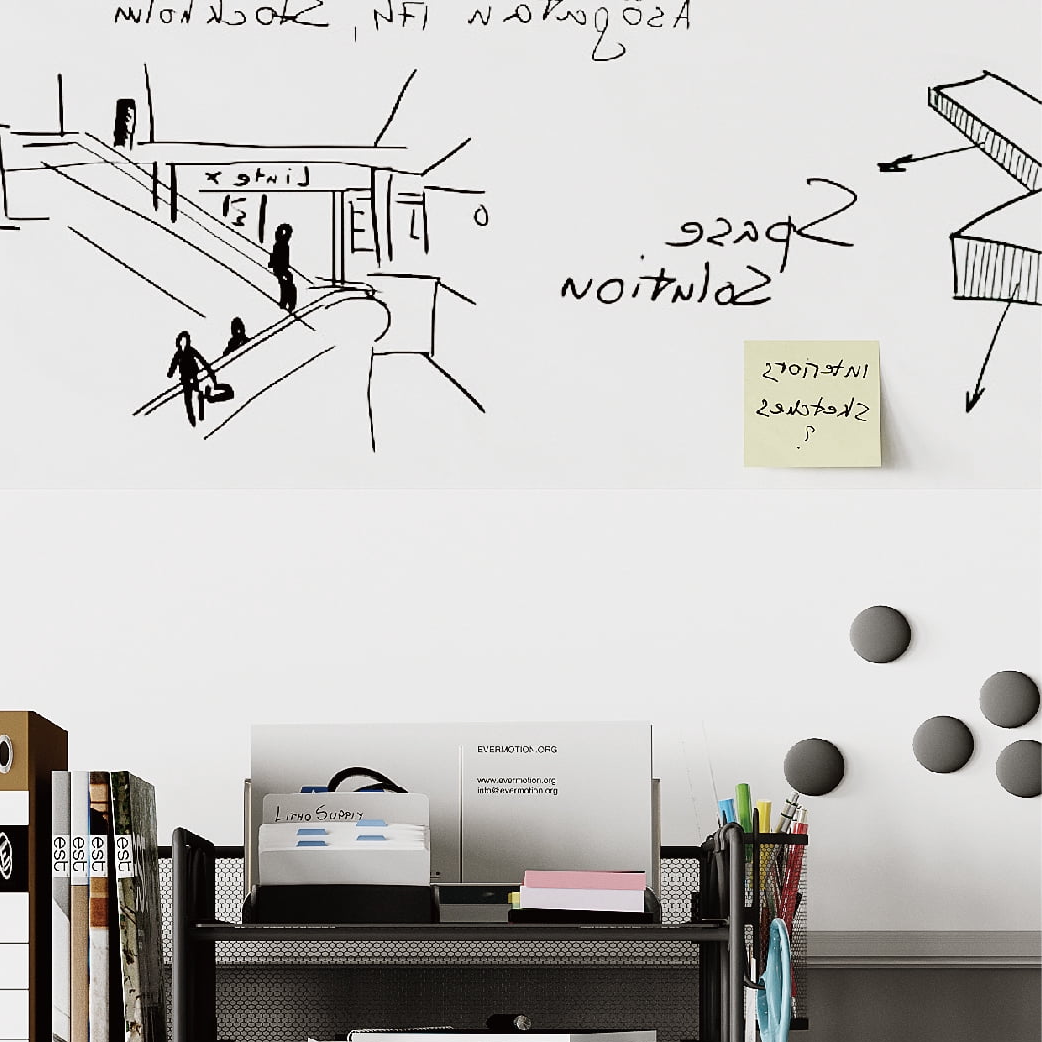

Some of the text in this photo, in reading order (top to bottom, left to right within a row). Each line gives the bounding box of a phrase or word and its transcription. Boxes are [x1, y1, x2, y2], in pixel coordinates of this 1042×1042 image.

[477, 745, 558, 754] EVERMOTION.ORG
[476, 777, 556, 786] www.evermotion.org
[53, 836, 69, 872] est
[72, 836, 88, 872] est
[91, 836, 106, 872] est
[116, 836, 132, 872] est
